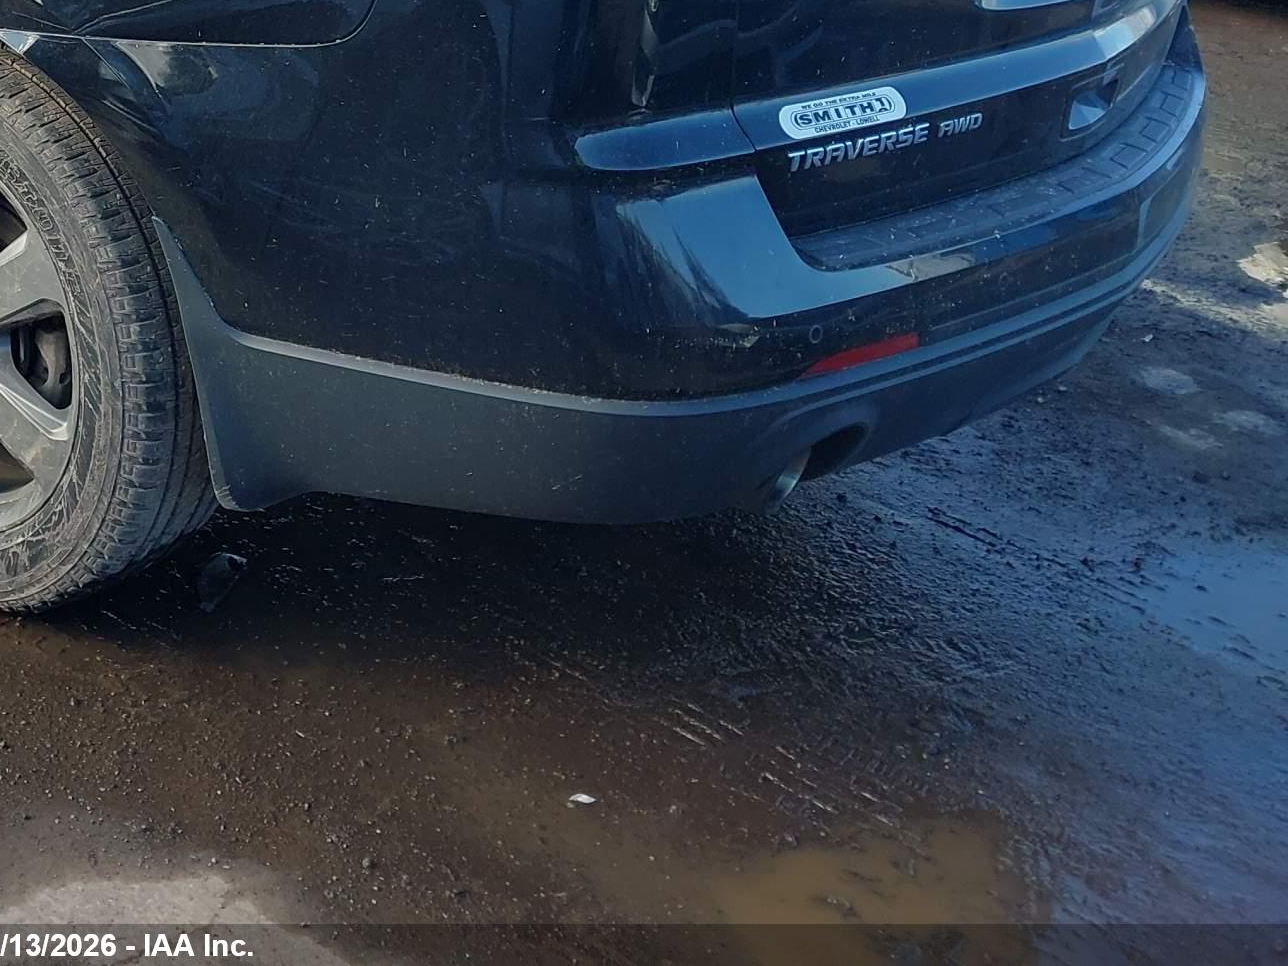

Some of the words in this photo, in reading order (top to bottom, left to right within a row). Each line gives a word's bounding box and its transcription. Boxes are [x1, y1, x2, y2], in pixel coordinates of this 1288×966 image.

[824, 98, 838, 106] THE
[814, 120, 852, 133] CHEVROLET
[856, 115, 880, 126] LOWELL
[788, 122, 930, 172] TRAVERSE
[938, 113, 983, 137] AWD
